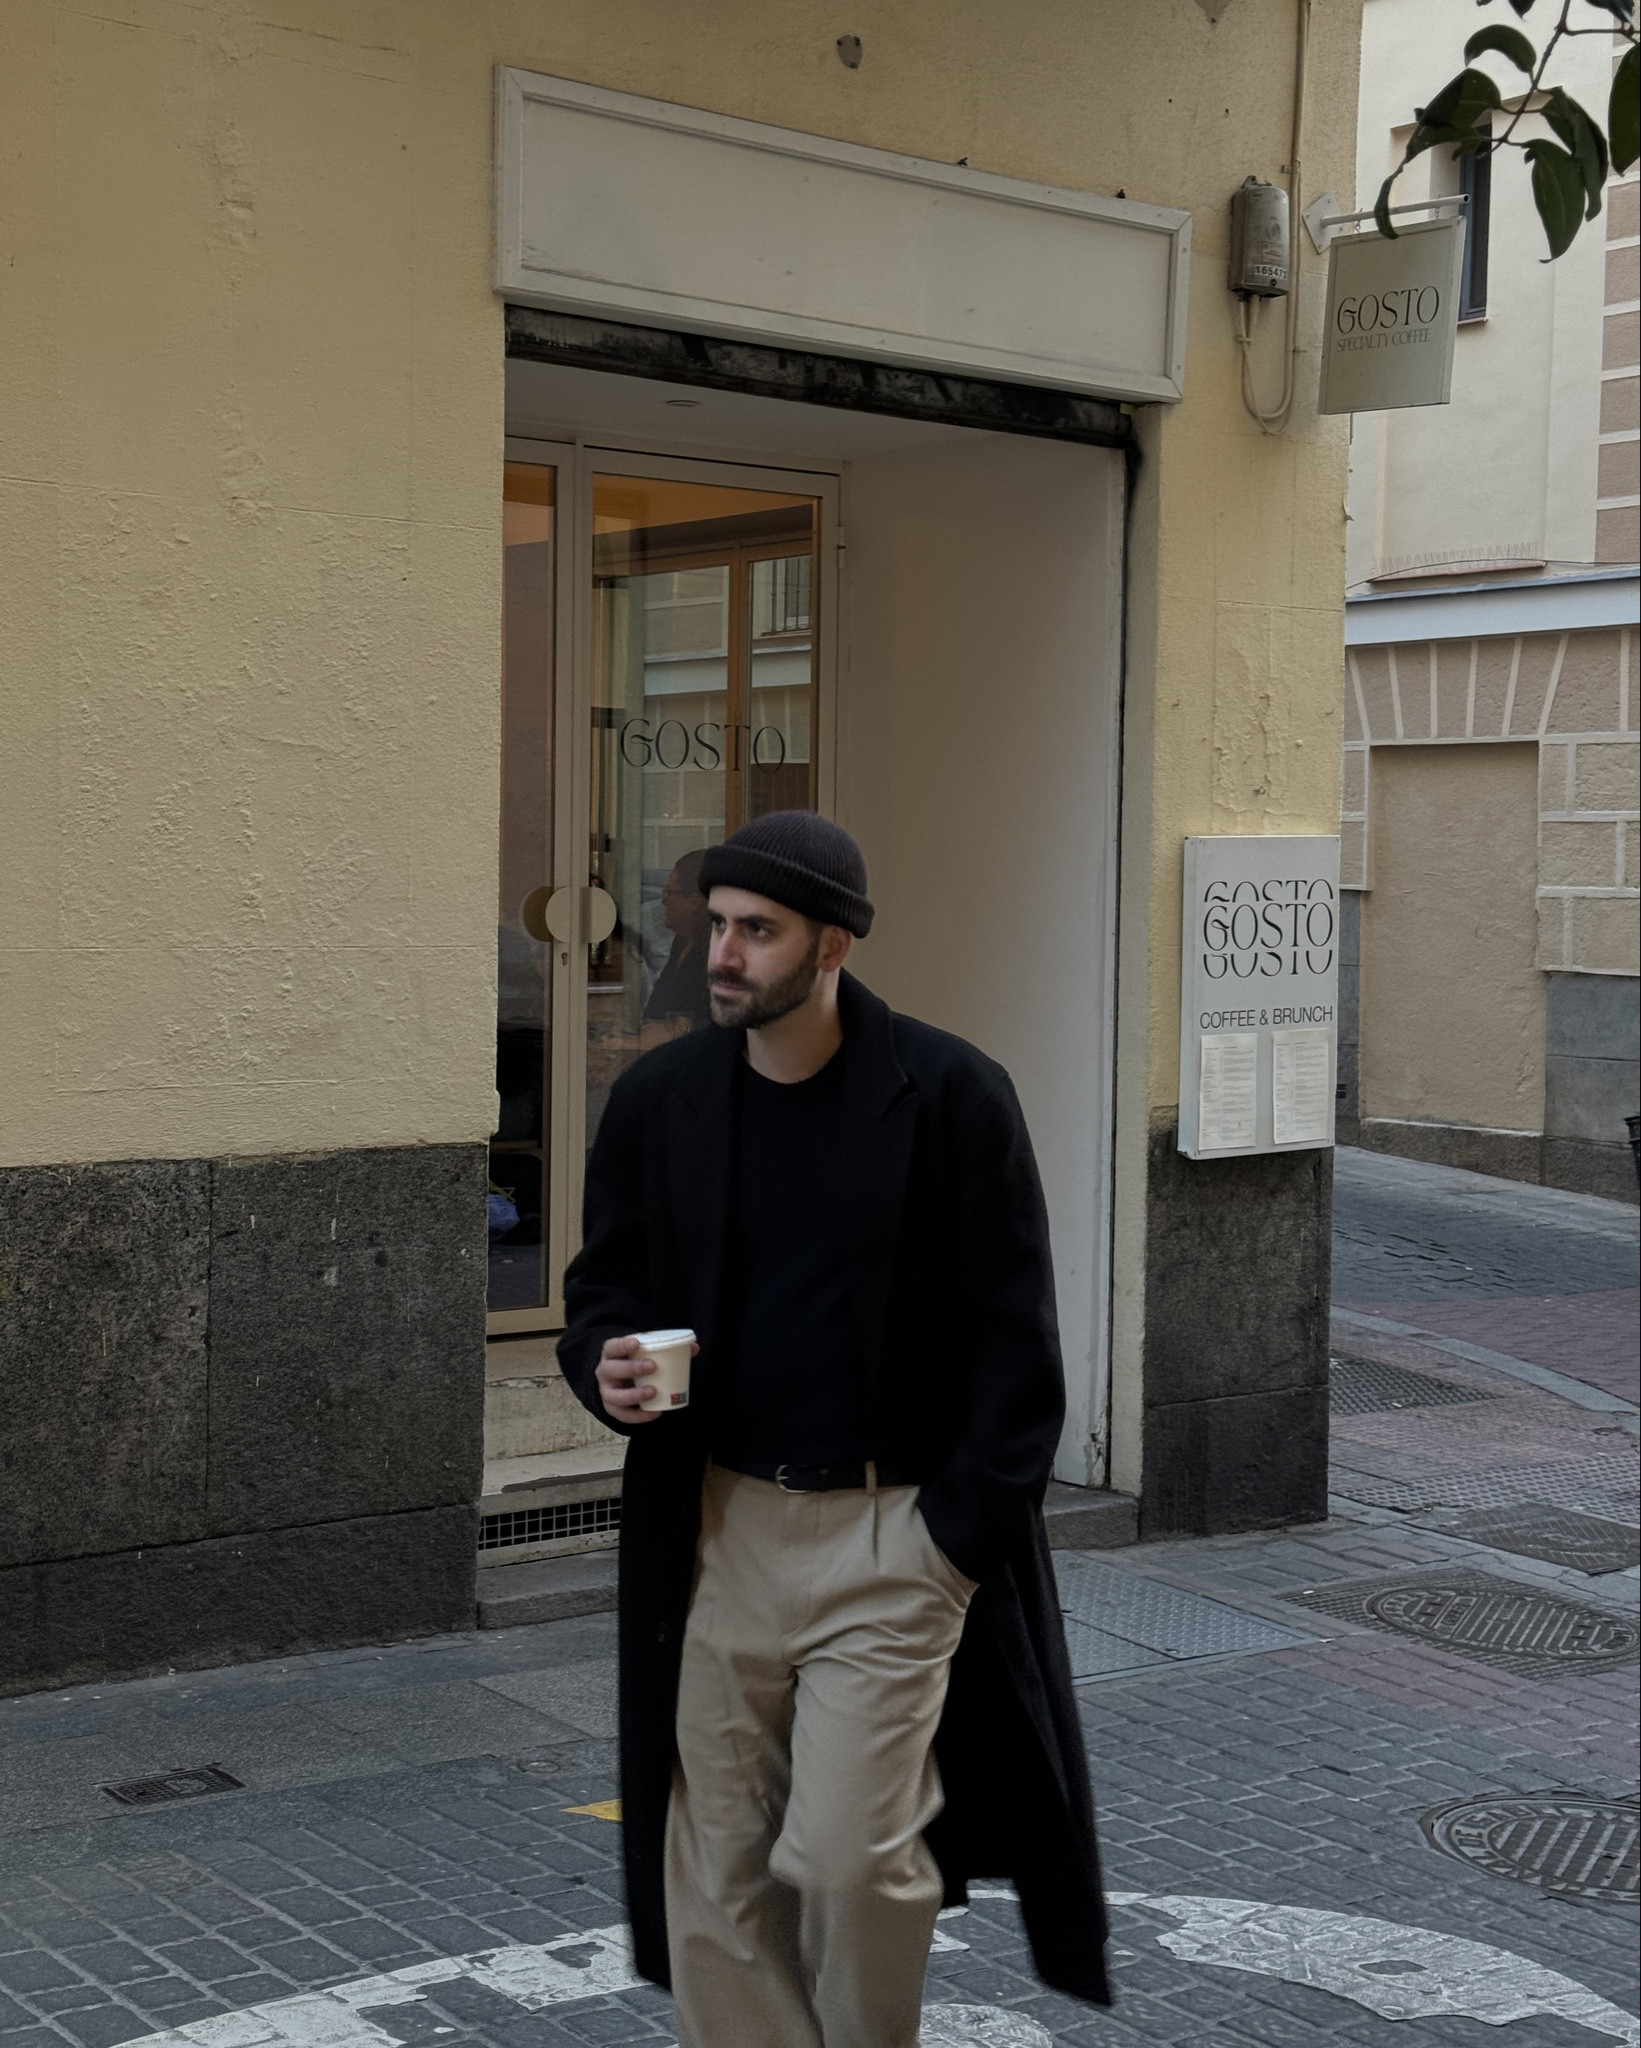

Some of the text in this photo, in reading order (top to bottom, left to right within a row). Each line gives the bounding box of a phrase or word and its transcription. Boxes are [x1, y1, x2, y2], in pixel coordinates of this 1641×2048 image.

[1337, 286, 1440, 334] GOSTO
[1336, 327, 1432, 353] SPECIALTY COFFEE
[620, 718, 786, 774] GOSTO
[1203, 902, 1333, 951] GOSTO
[1200, 1005, 1333, 1029] COFFEE & BRUNCH
